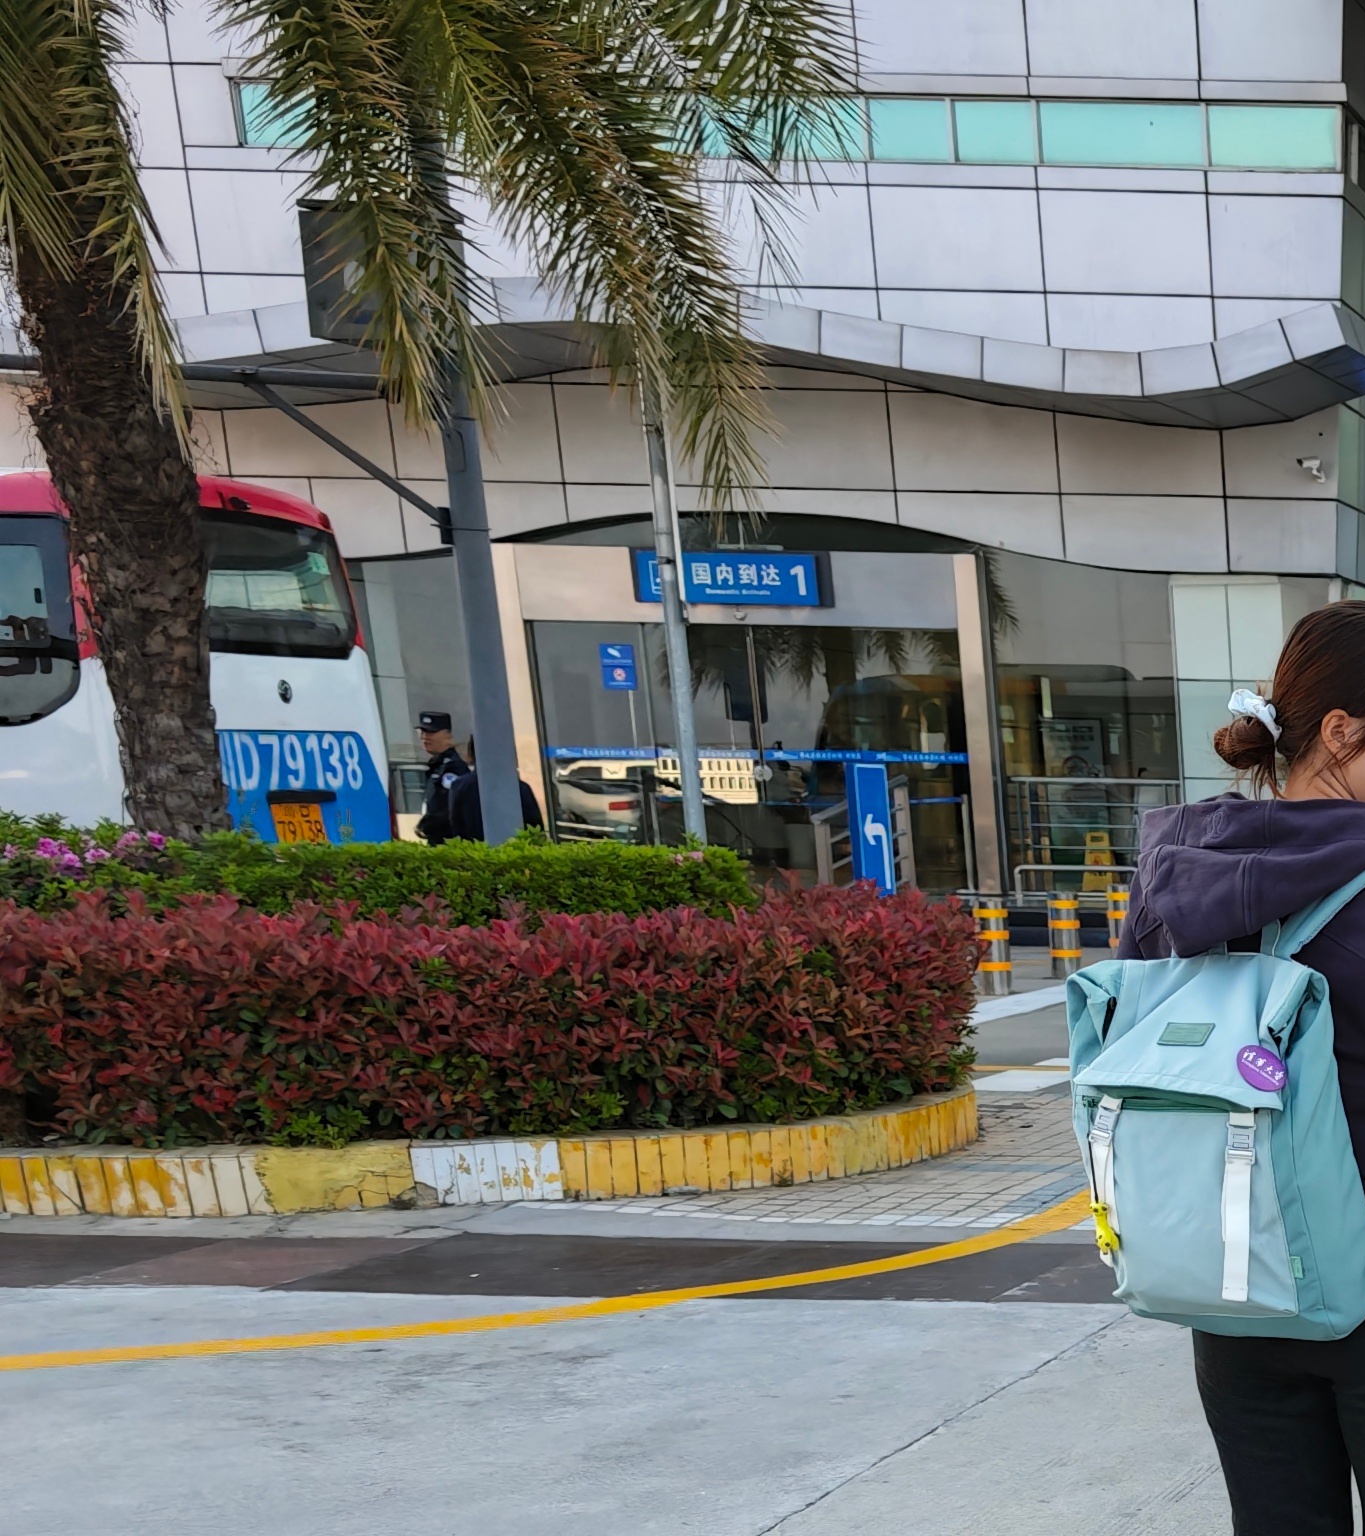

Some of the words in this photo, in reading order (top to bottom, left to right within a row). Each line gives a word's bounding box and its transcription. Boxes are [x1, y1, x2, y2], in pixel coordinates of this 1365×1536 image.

[691, 563, 782, 586] 国内到达
[789, 565, 807, 596] 1
